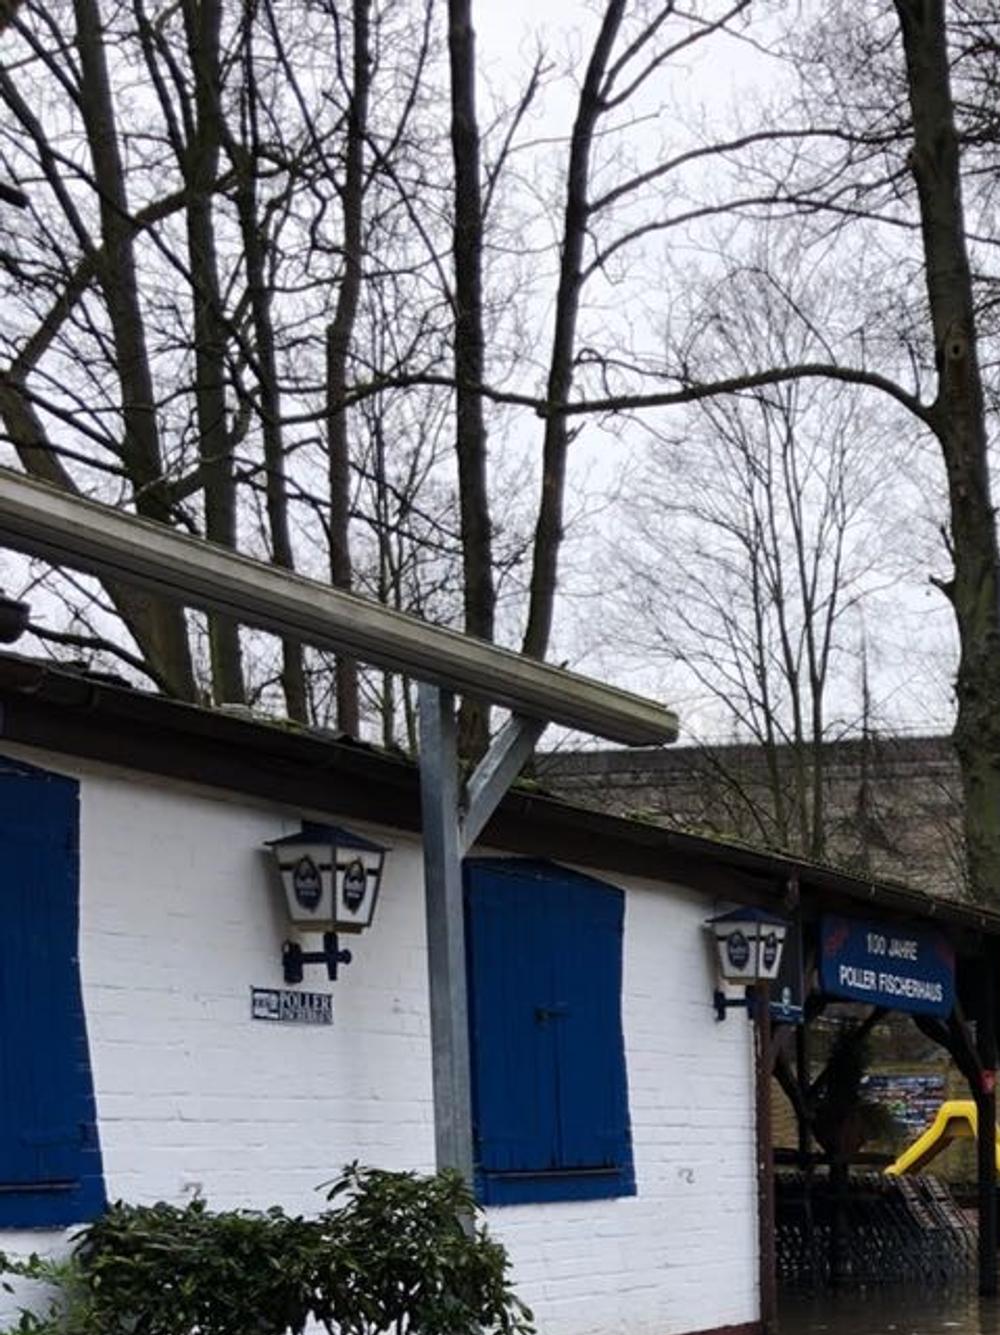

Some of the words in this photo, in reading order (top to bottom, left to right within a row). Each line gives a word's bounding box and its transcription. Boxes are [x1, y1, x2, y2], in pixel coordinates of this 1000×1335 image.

[867, 932, 885, 956] 100
[888, 938, 918, 961] JAHRE
[839, 964, 877, 991] POLLER
[879, 972, 943, 1003] FISCHERHAUS
